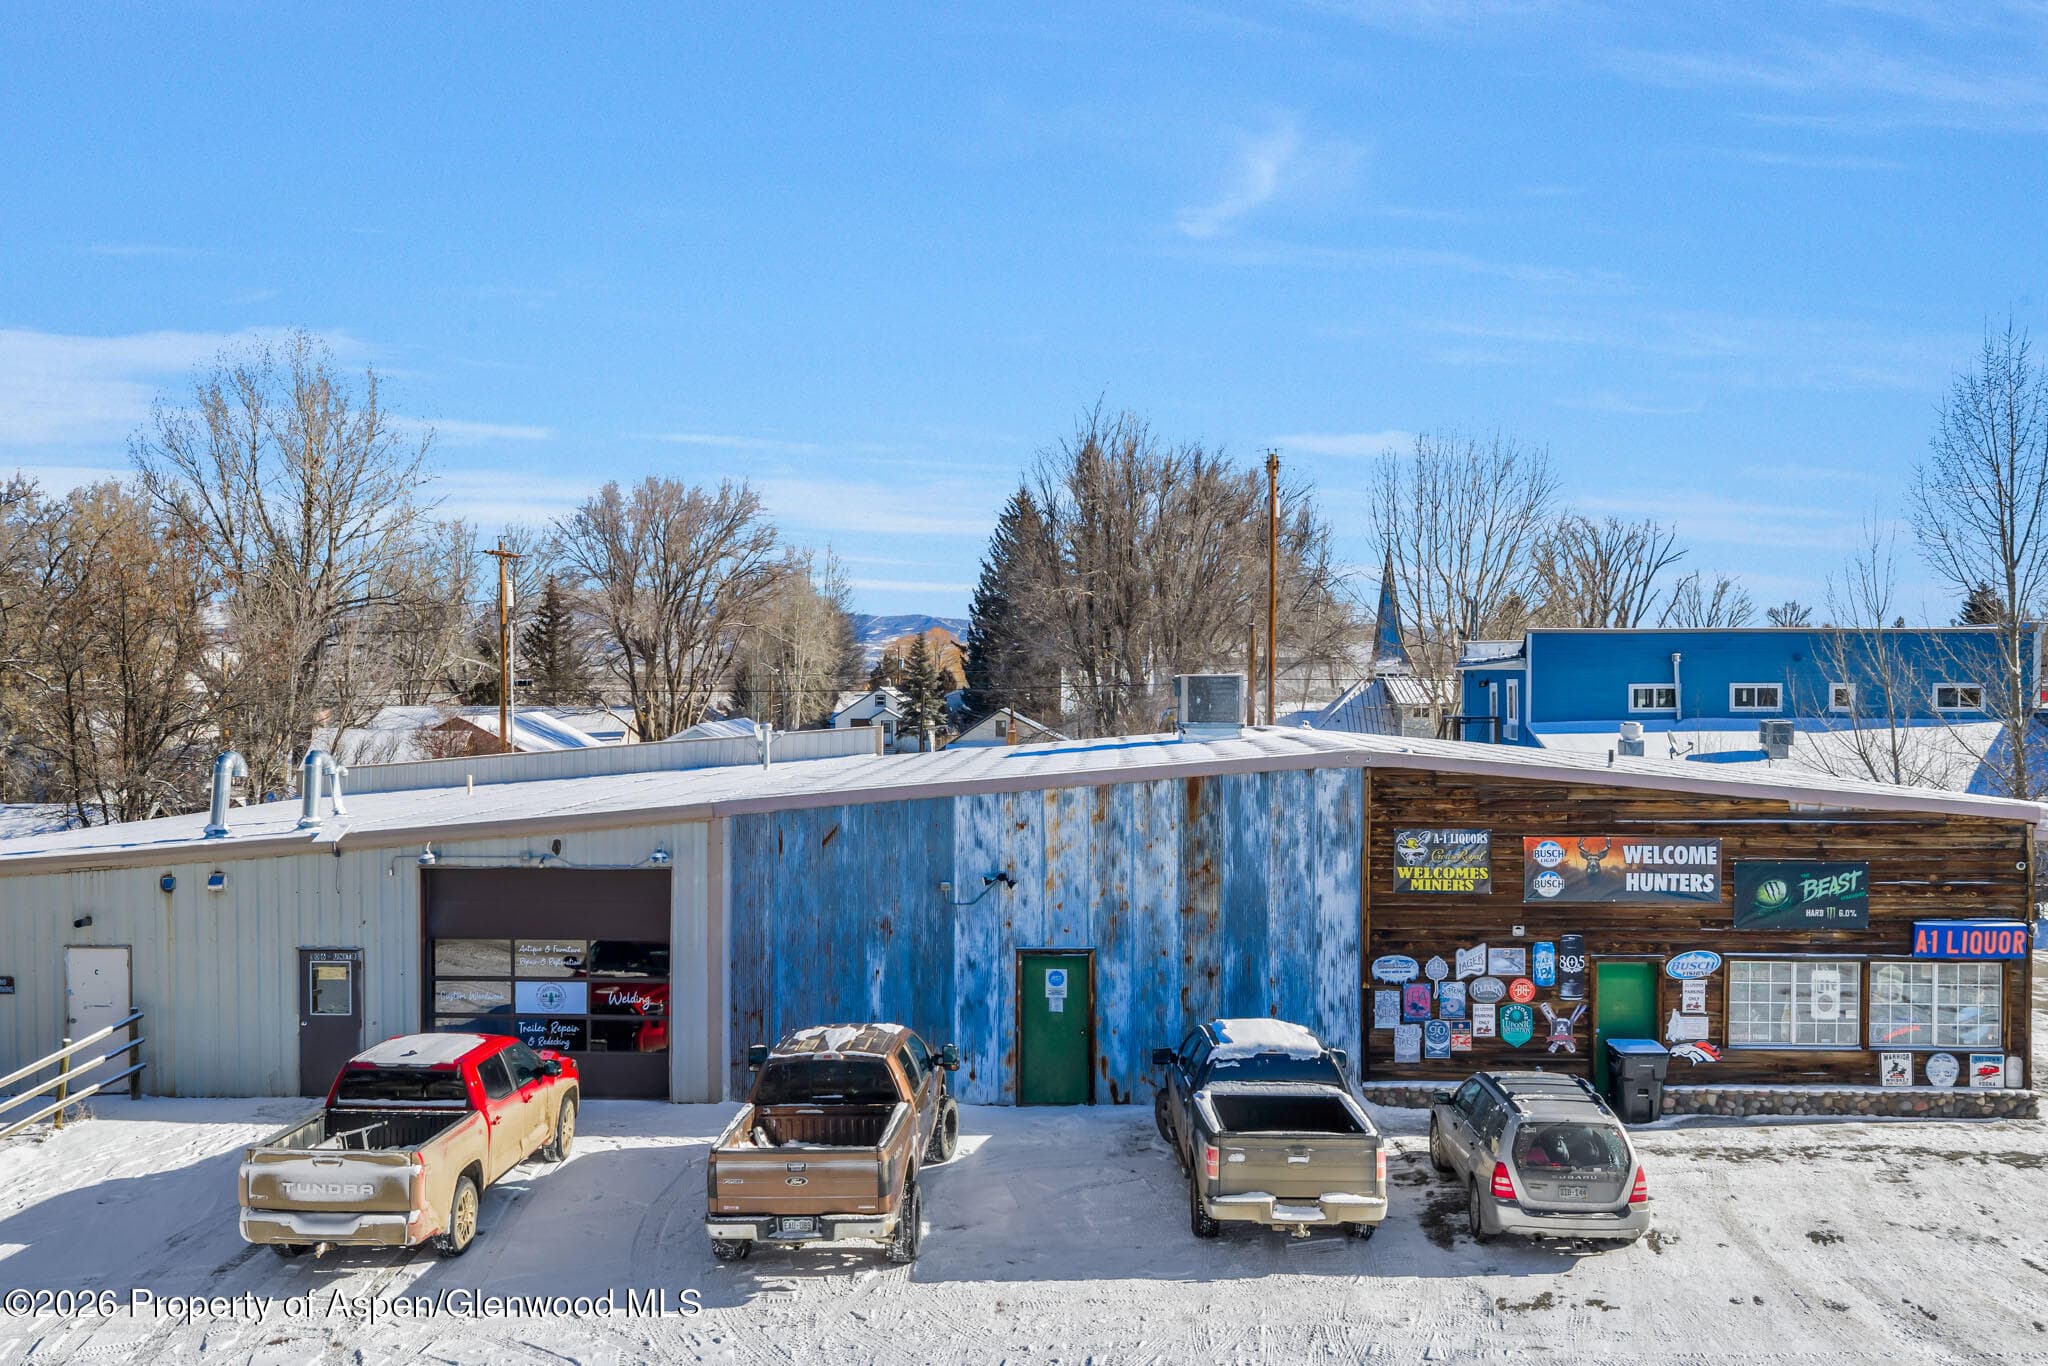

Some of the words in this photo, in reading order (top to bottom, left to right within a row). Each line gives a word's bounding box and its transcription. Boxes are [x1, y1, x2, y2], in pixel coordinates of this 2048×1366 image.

[1433, 833, 1447, 844] A-1
[1450, 833, 1488, 844] LIQUORS
[1534, 849, 1564, 858] BUSCH
[1623, 845, 1717, 866] WELCOME
[1396, 866, 1489, 880] WELCOMES
[1410, 879, 1475, 892] MINERS
[1534, 879, 1564, 889] BUSCH
[1625, 873, 1715, 893] HUNTERS
[1798, 869, 1863, 903] BEAST
[1805, 908, 1825, 918] HARD
[1838, 908, 1858, 918] 6.0%
[1946, 930, 2026, 955] LIQUOR
[1559, 955, 1585, 970] 805
[1671, 961, 1717, 971] BUSCH
[608, 991, 652, 1010] Welding
[518, 1021, 548, 1034] Trailer
[550, 1020, 581, 1038] Repair
[281, 1181, 375, 1195] TUNDRA
